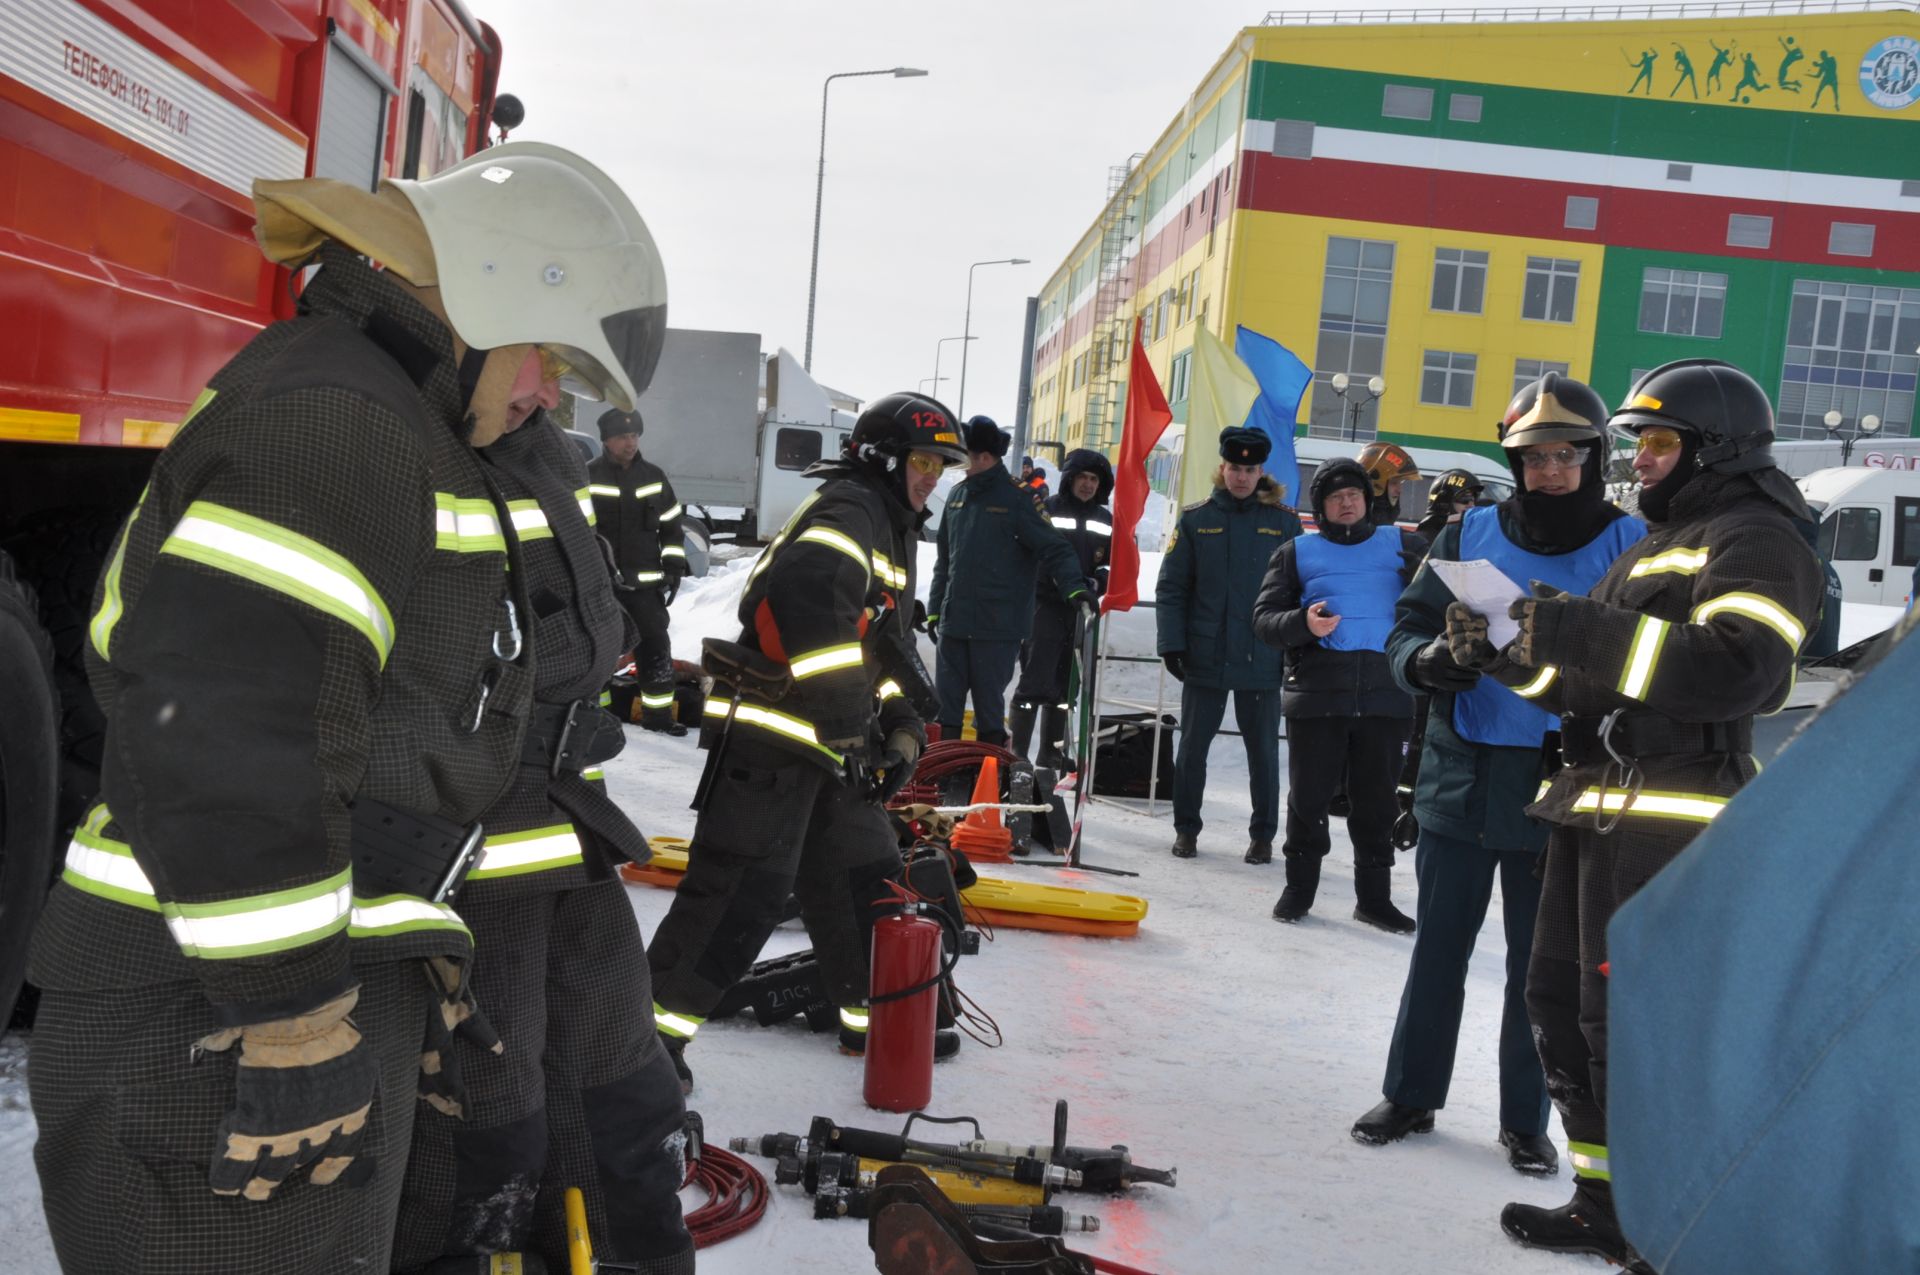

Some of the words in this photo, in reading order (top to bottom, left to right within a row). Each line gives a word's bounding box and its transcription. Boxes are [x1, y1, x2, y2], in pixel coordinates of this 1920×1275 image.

[63, 41, 128, 102] ТЕЛЕФОН
[131, 81, 152, 120] 112,
[177, 109, 190, 136] 01
[911, 411, 946, 428] 129
